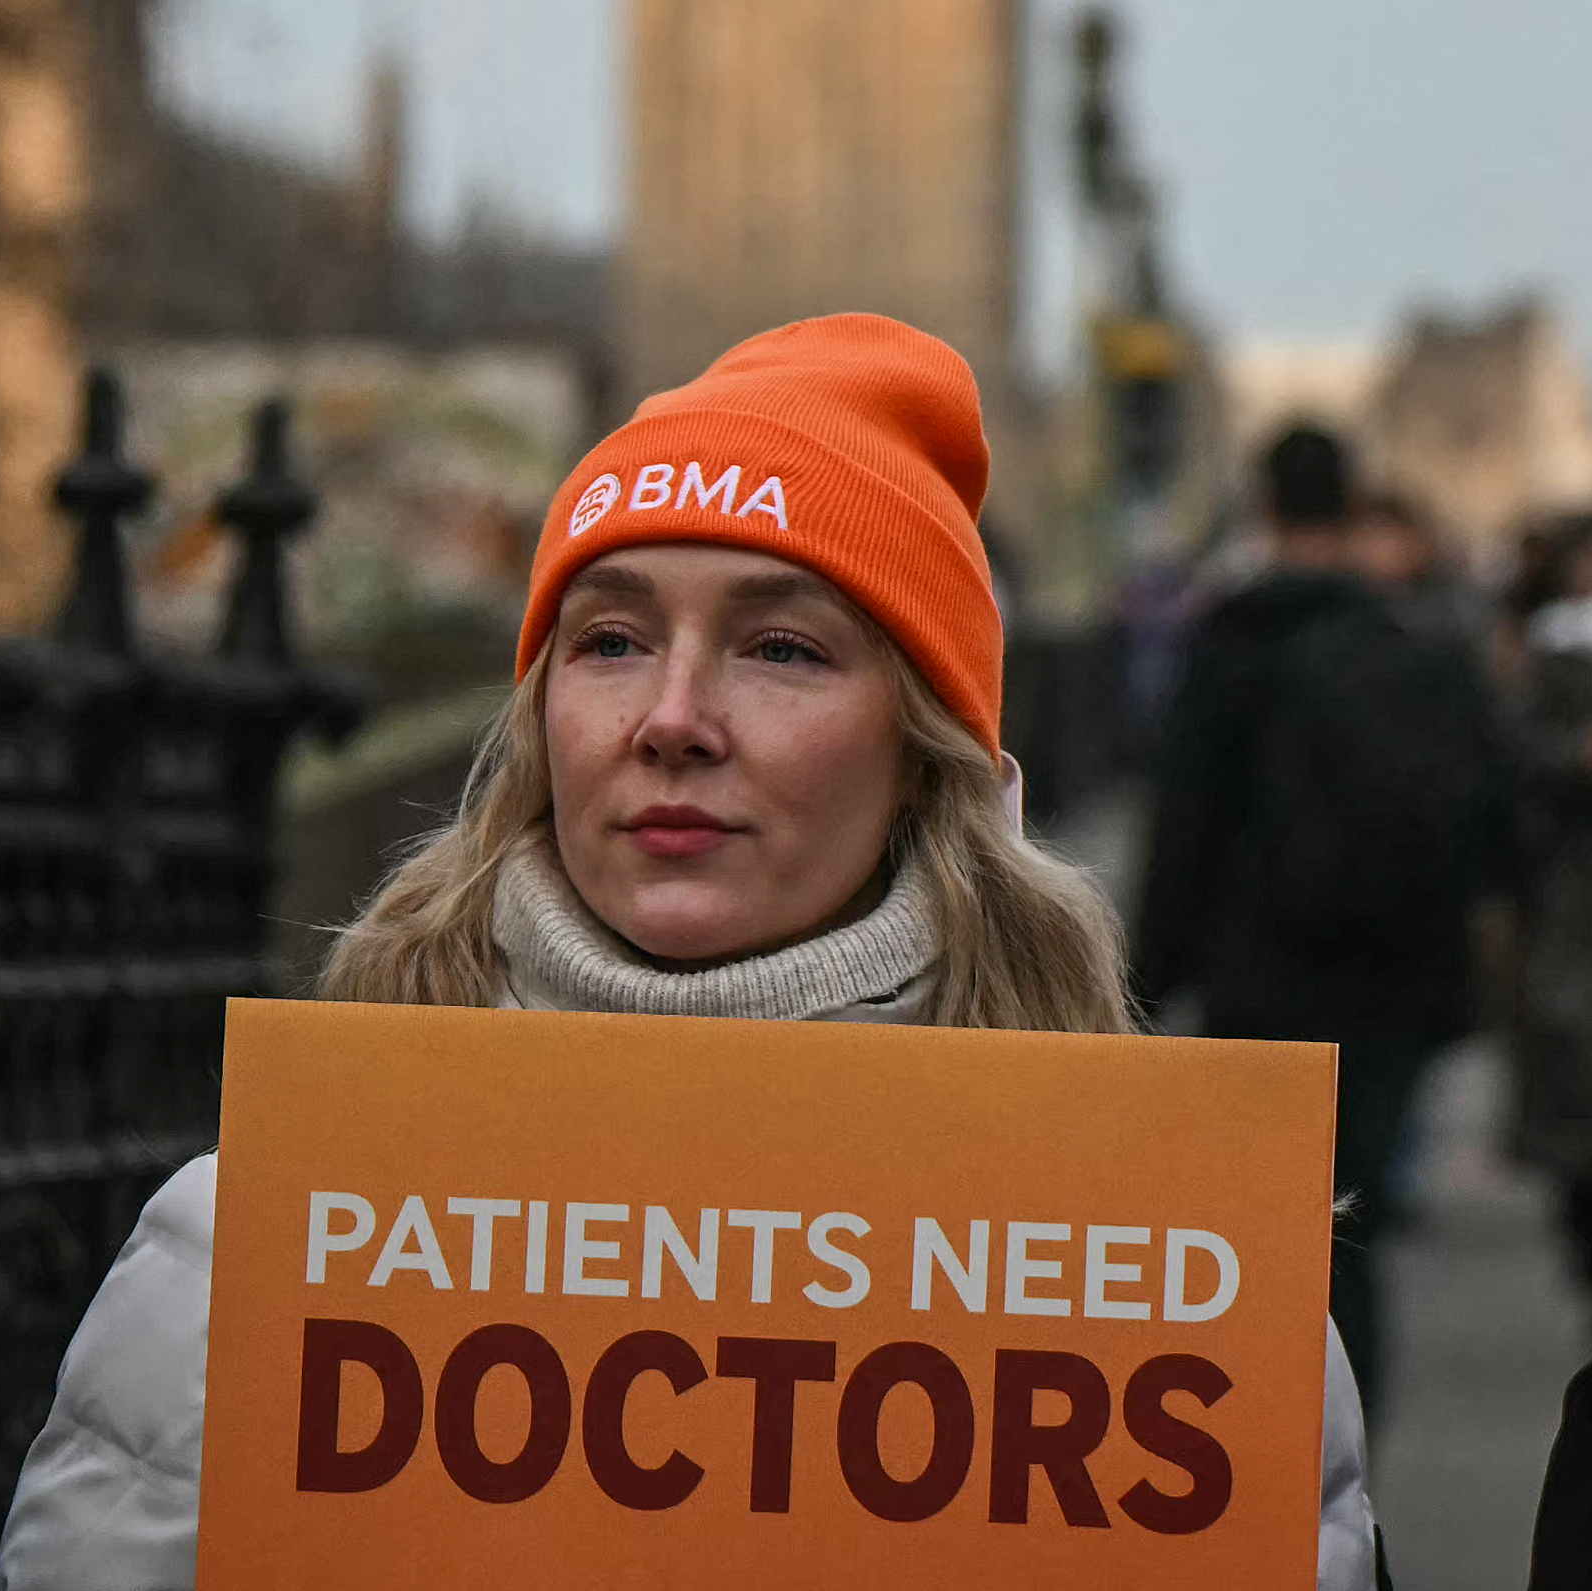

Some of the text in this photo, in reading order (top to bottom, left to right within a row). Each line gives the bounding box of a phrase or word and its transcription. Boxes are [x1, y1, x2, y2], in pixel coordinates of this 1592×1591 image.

[628, 461, 788, 531] BMA
[307, 1192, 1239, 1322] PATIENTS NEED
[296, 1318, 1233, 1534] DOCTORS
